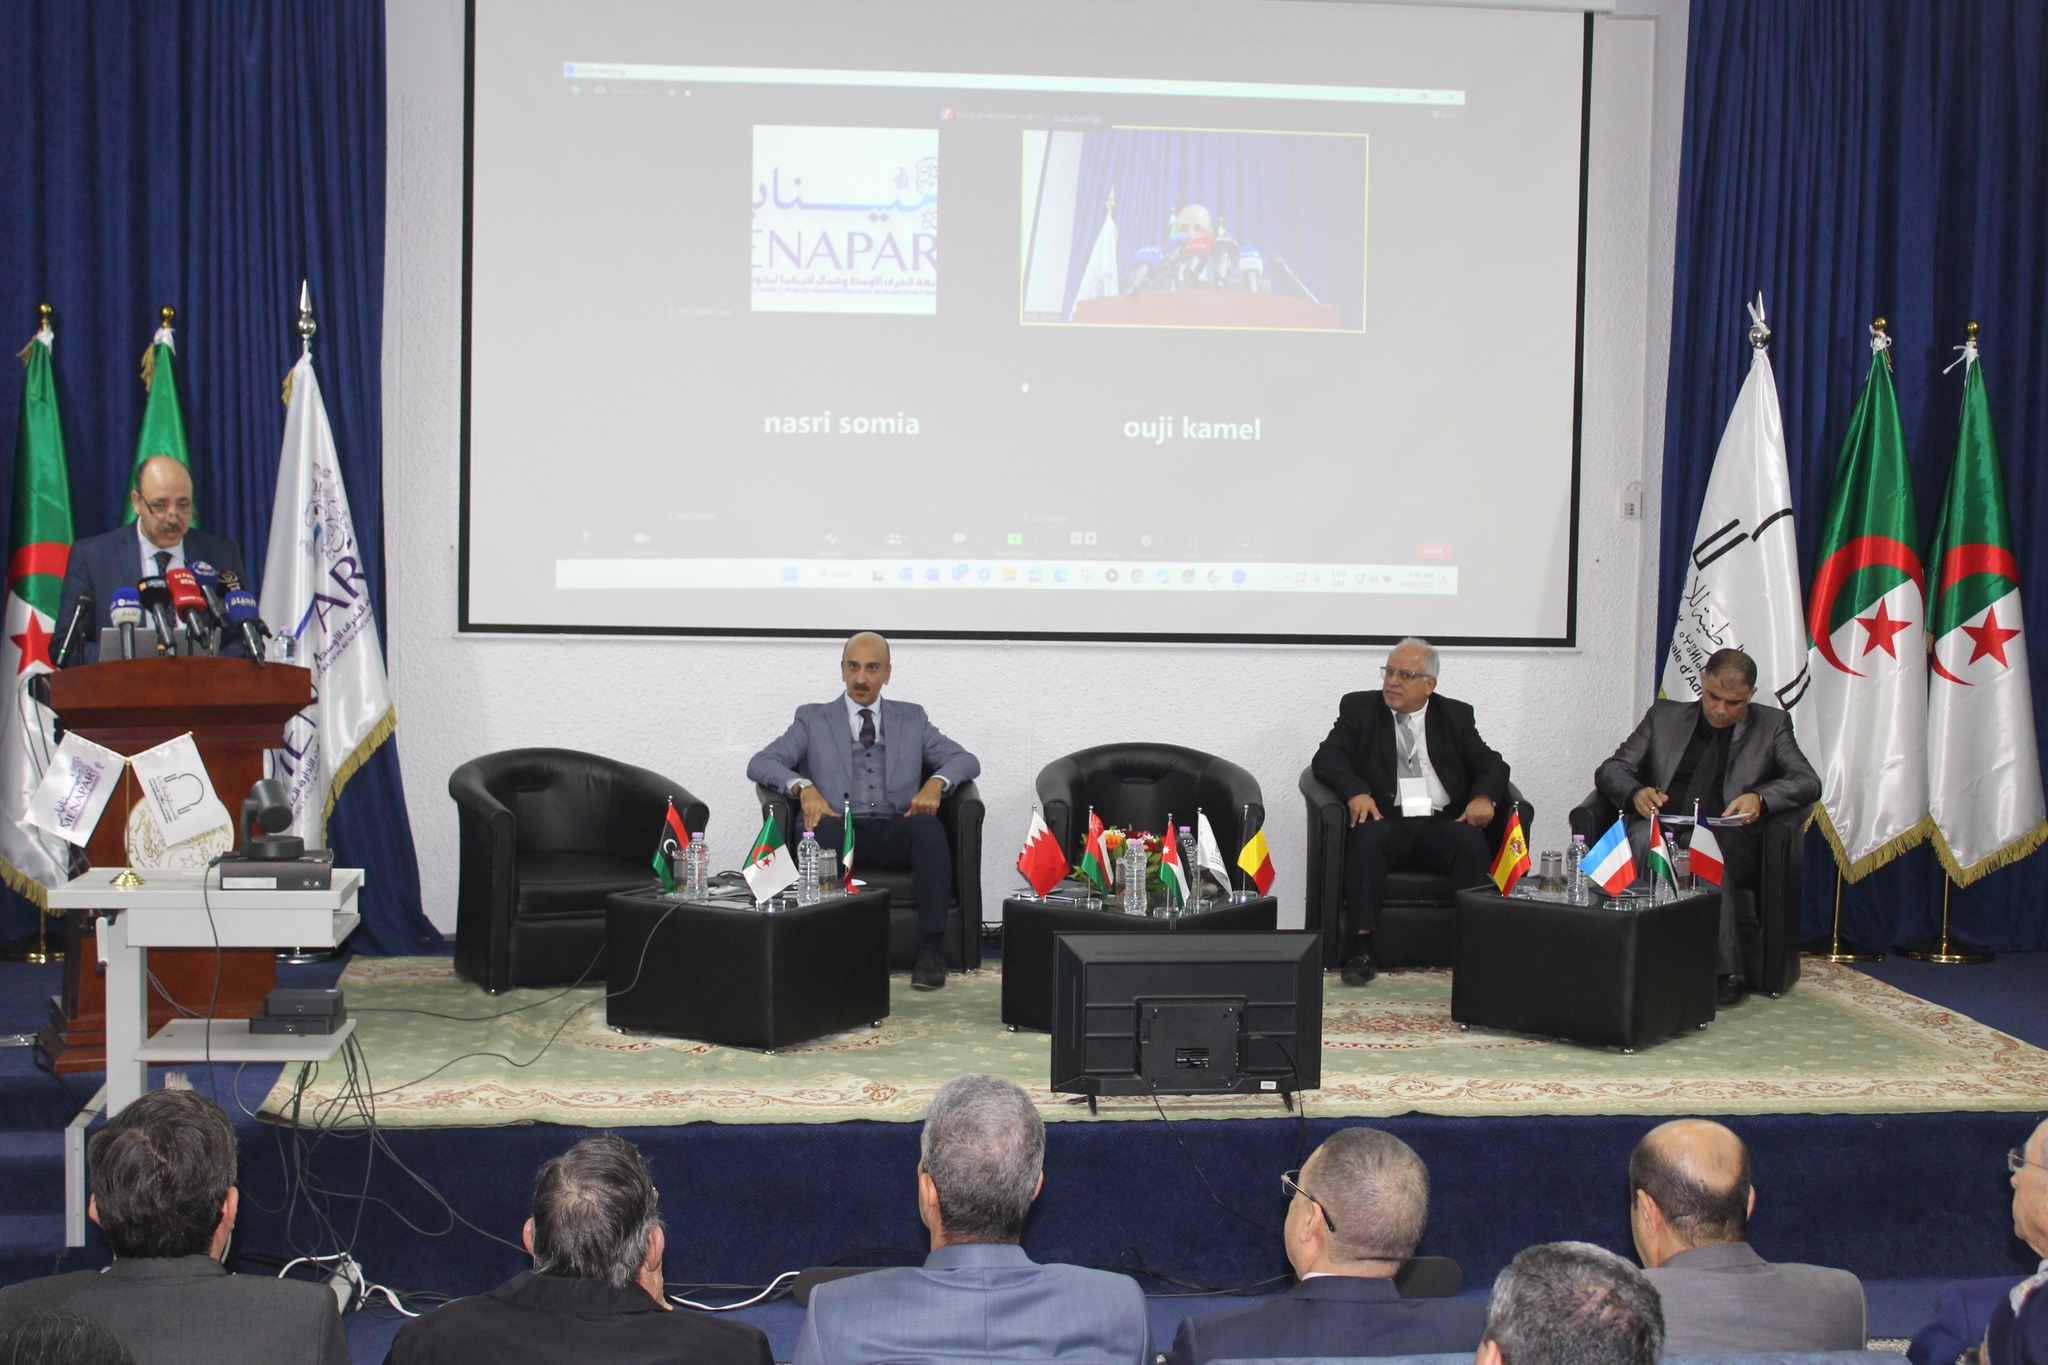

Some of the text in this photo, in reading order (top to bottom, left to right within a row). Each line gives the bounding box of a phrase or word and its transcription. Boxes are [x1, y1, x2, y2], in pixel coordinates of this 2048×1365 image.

[764, 411, 920, 436] nasri somia
[1124, 416, 1262, 445] ouji kamel
[60, 771, 95, 829] MENAPAR
